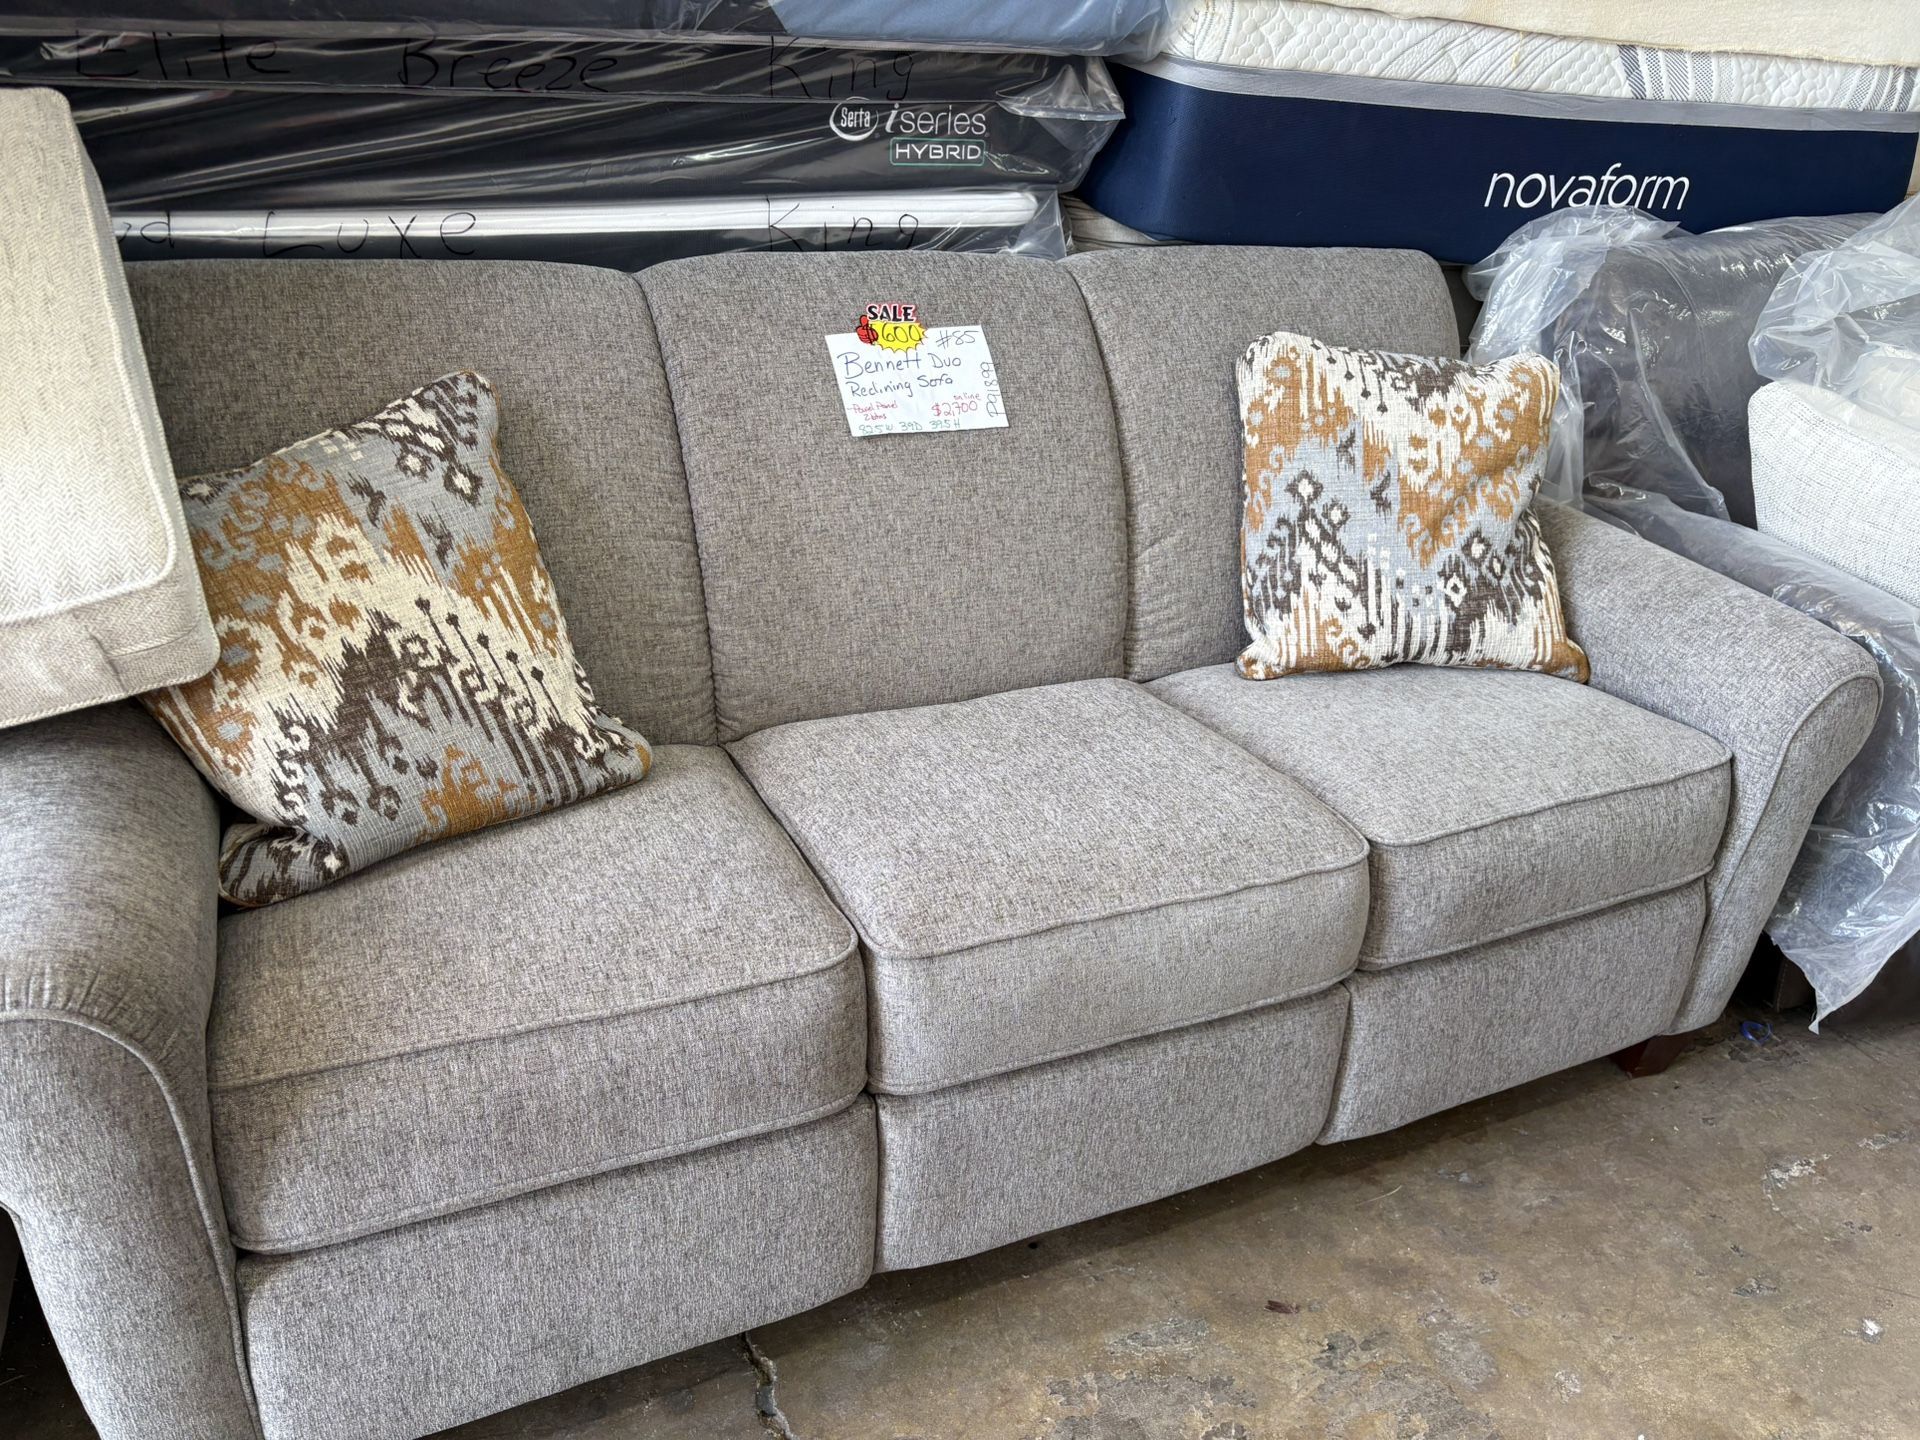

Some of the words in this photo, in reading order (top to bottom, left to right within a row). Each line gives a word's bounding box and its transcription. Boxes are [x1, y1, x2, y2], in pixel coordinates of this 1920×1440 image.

[75, 30, 290, 80] Elite
[398, 26, 618, 92] Breeze
[769, 35, 914, 101] King
[840, 106, 871, 128] Serta
[895, 143, 982, 160] HYBRID
[1483, 163, 1691, 210] novaform
[263, 211, 476, 259] Luxe
[765, 194, 919, 251] King
[867, 305, 915, 321] SALE
[936, 330, 979, 349] #85
[837, 351, 921, 380] Bennett
[928, 353, 961, 368] Duo
[846, 379, 913, 398] Reclining
[917, 373, 953, 388] Sofa
